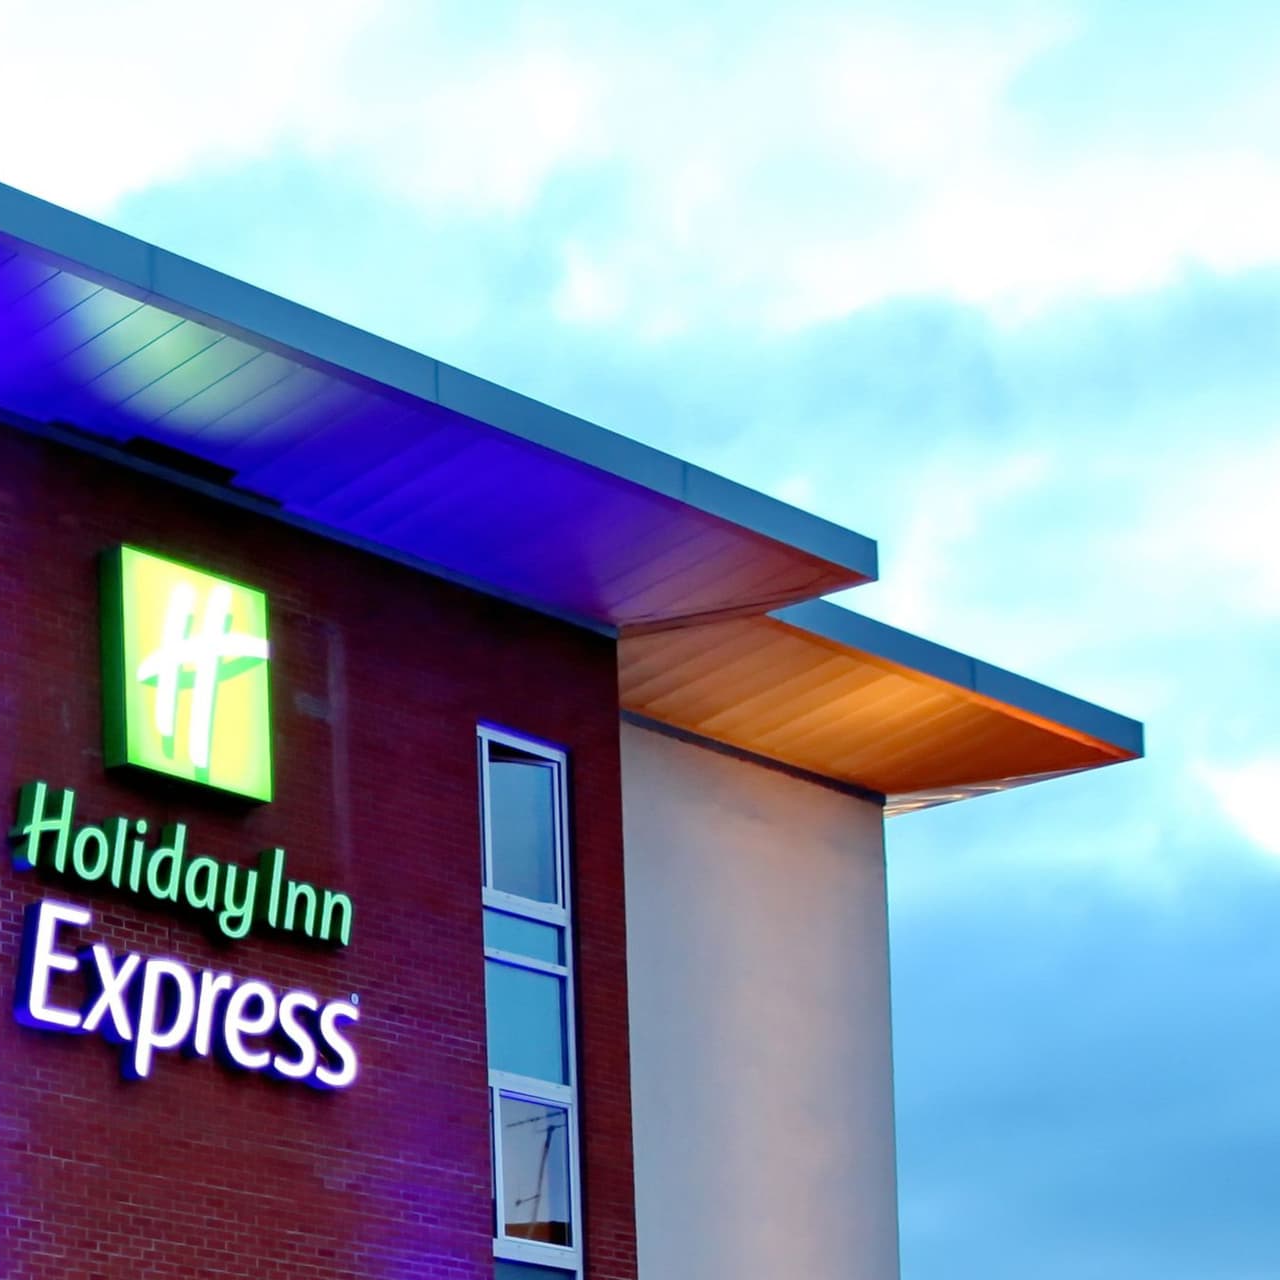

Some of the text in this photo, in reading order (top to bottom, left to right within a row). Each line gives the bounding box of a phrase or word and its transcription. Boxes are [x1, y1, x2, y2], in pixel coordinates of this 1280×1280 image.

[12, 779, 353, 946] Holiday Inn
[25, 899, 360, 1087] Express
